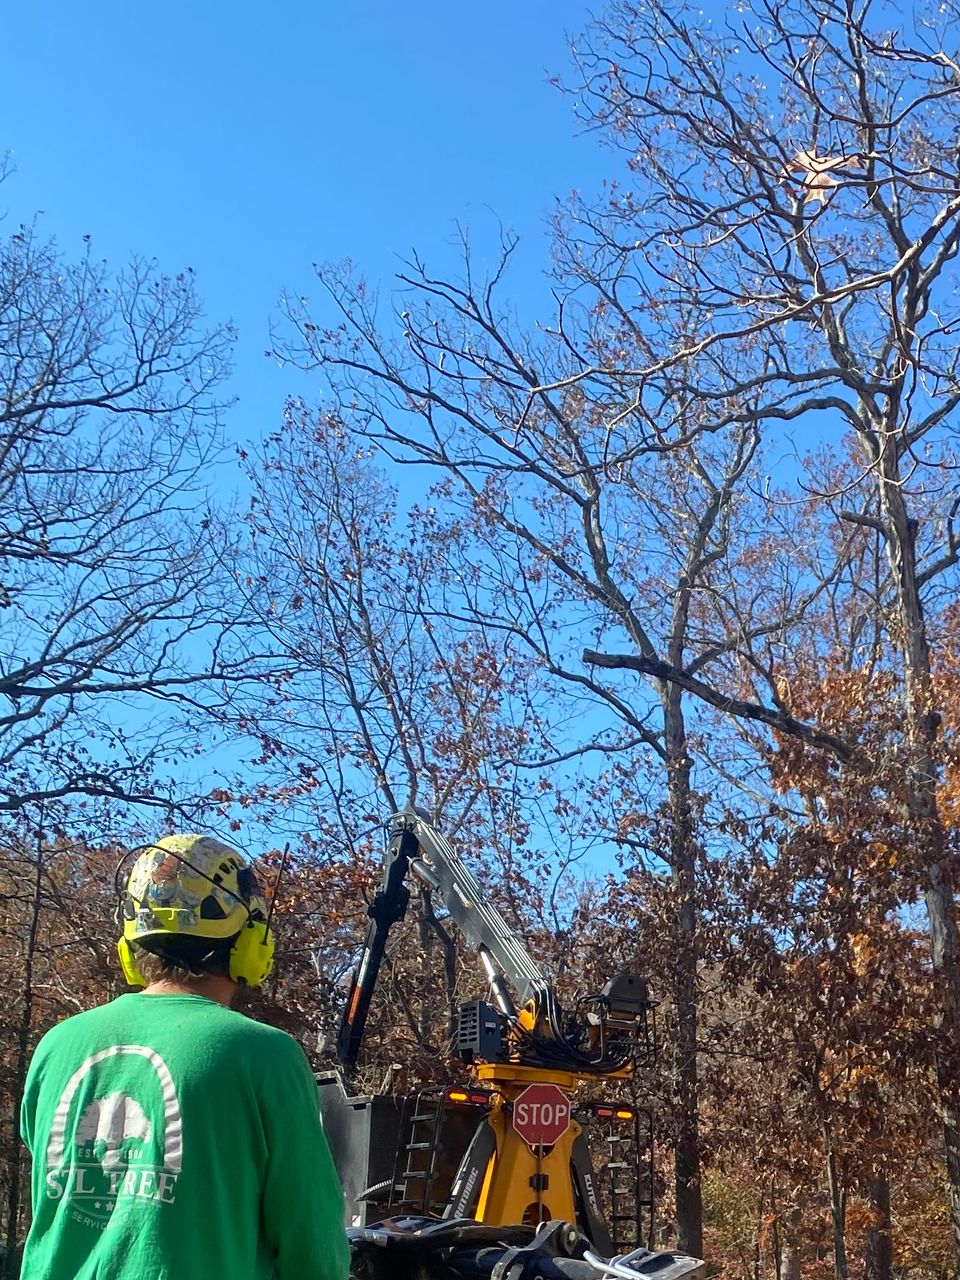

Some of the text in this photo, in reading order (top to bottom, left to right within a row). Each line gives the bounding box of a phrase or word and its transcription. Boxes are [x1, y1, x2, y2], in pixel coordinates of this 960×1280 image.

[517, 1103, 567, 1126] STOP
[46, 1168, 178, 1204] SL TREE
